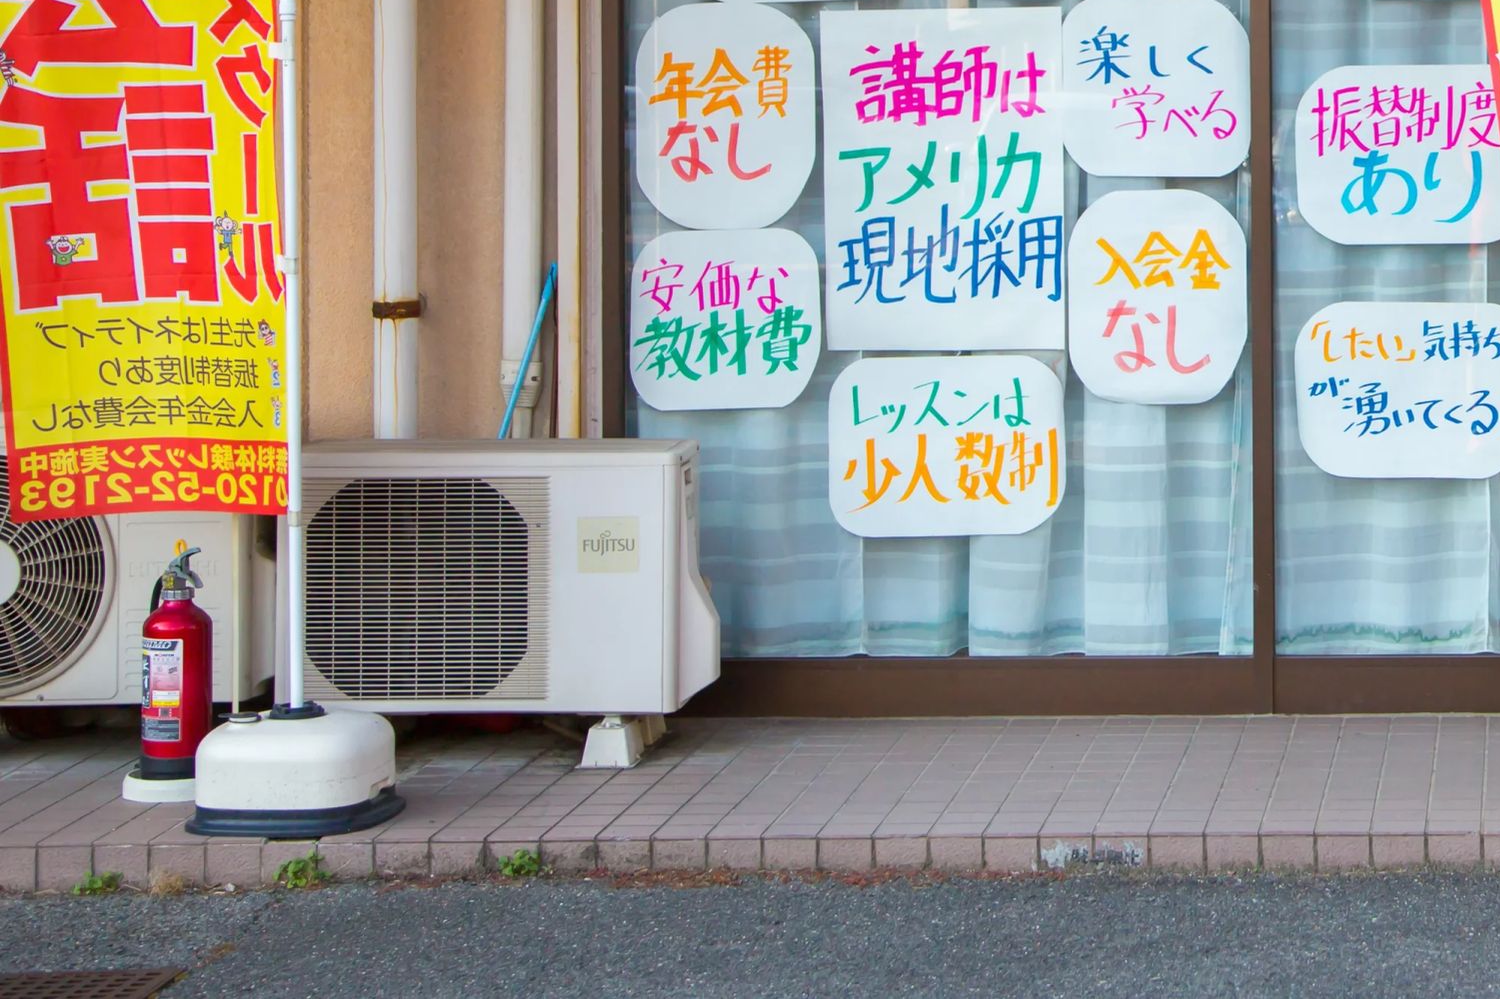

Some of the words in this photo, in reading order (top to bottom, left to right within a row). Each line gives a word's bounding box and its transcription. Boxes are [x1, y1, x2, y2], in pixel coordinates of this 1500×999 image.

[648, 45, 793, 121] 年会費
[849, 39, 1047, 127] 講師は
[1075, 25, 1214, 84] 楽しく
[1111, 85, 1238, 141] 学べる
[659, 121, 773, 183] なし
[838, 131, 1043, 219] アメリカ
[1341, 150, 1482, 223] あり
[640, 257, 789, 316] 安価な
[836, 203, 1063, 304] 現地採用
[1093, 228, 1231, 291] 入会金
[632, 305, 813, 382] 教材費
[1101, 299, 1213, 376] なし
[852, 377, 1031, 434] レッスンは
[1309, 374, 1500, 439] が湧いてくる
[843, 427, 1059, 515] 少人数制
[581, 535, 635, 557] FUJITSU
